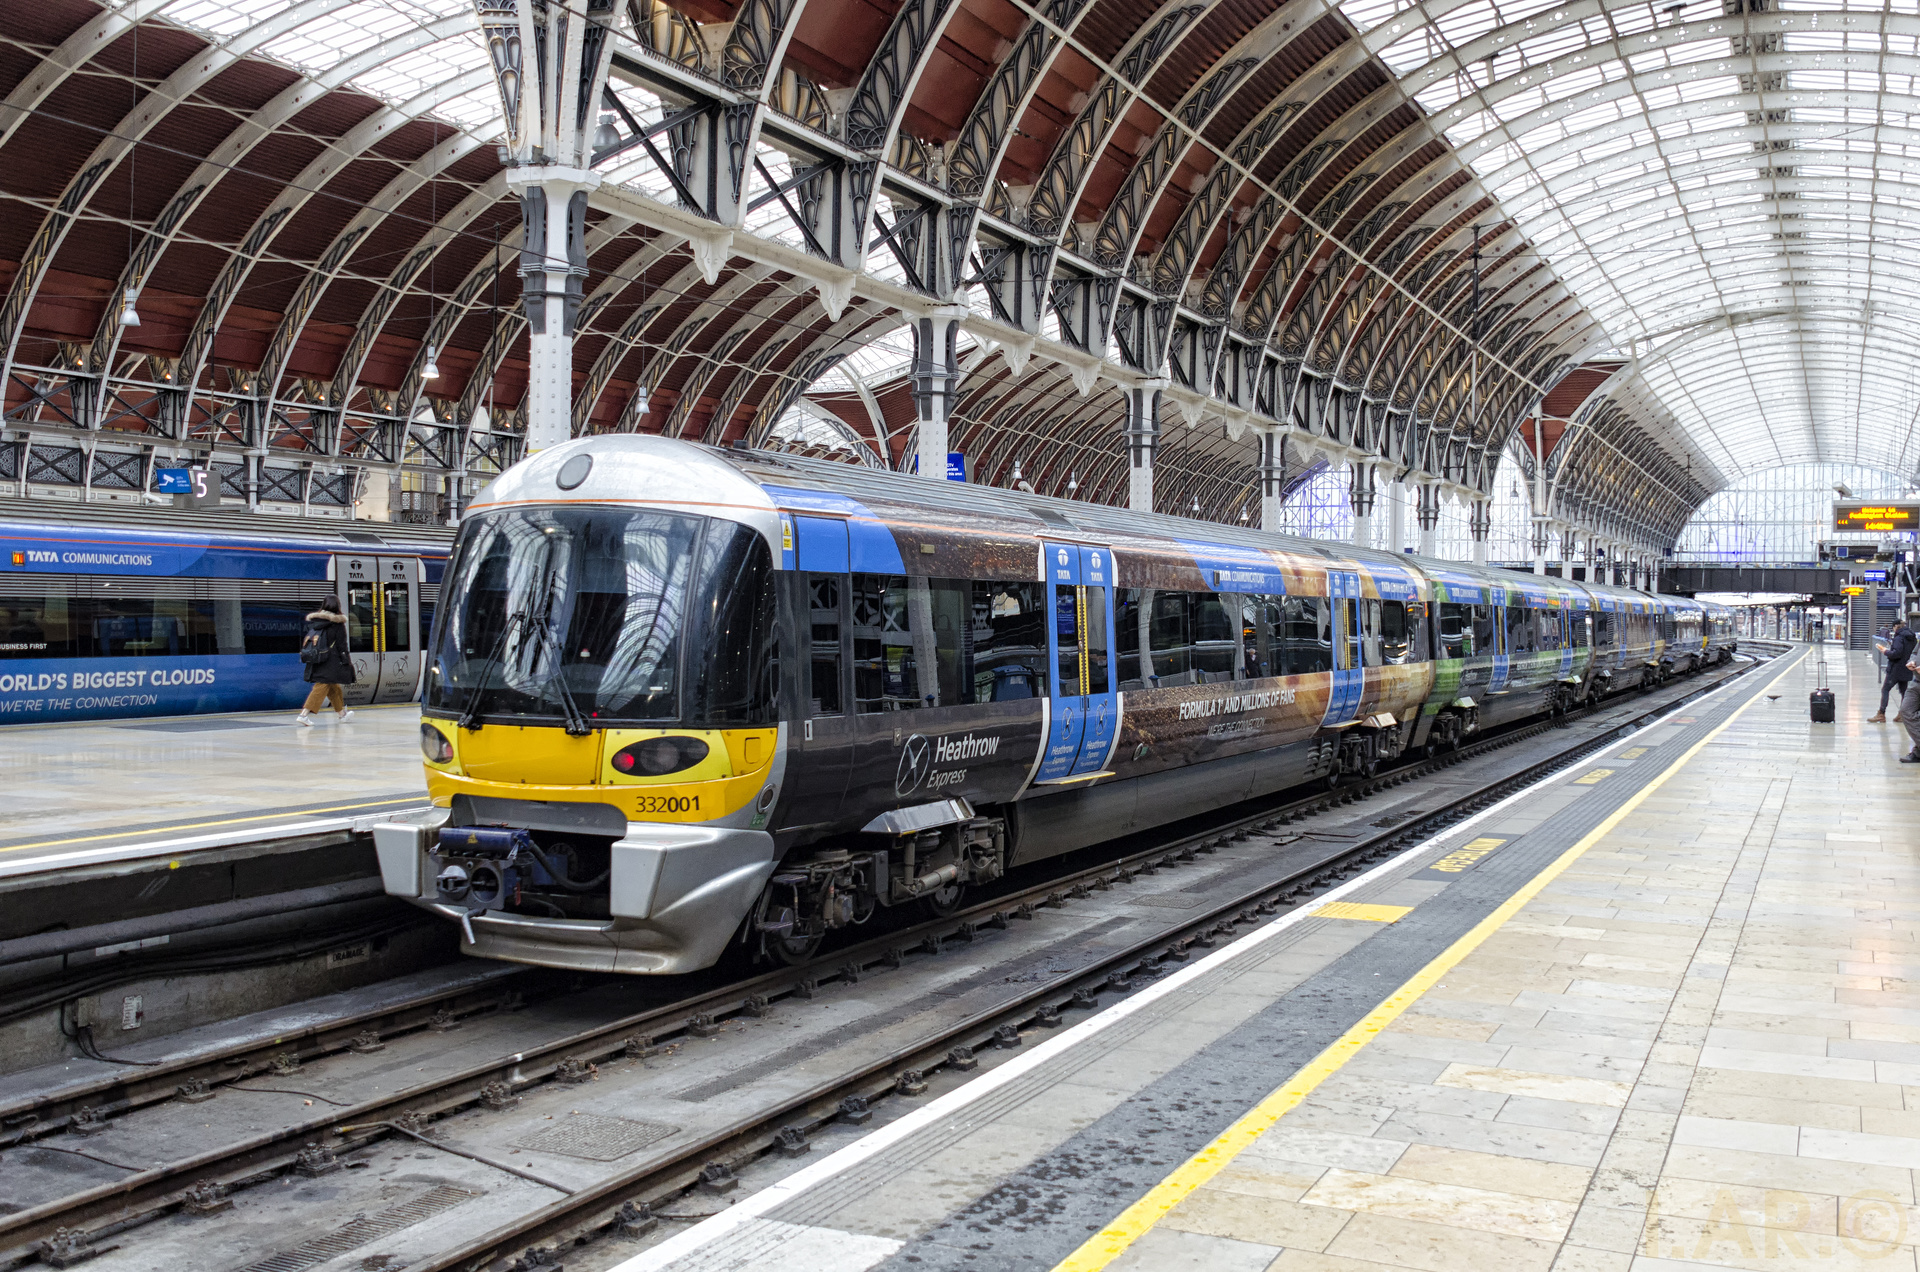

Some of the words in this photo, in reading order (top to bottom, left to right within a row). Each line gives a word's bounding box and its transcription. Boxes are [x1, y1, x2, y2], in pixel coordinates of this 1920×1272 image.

[196, 473, 208, 498] 5
[28, 551, 59, 563] TATA
[62, 552, 152, 566] COMMUNICATIONS
[1057, 570, 1071, 580] TATA
[1091, 572, 1103, 582] TATA
[73, 671, 147, 689] BIGGEST
[151, 669, 215, 685] CLOUDS
[1, 699, 44, 713] WE'RE
[48, 698, 72, 710] THE
[75, 695, 158, 709] CONNECTION
[1178, 699, 1216, 720] FORMULA
[1223, 696, 1240, 714] AND
[1240, 692, 1270, 712] MILLIONS
[1270, 690, 1280, 707] OF
[1279, 688, 1296, 705] FANS
[934, 733, 1000, 763] Heathrow
[1051, 745, 1075, 756] Heathrow
[1086, 740, 1108, 750] Heathrow
[926, 769, 967, 791] Express
[635, 795, 700, 813] 332001
